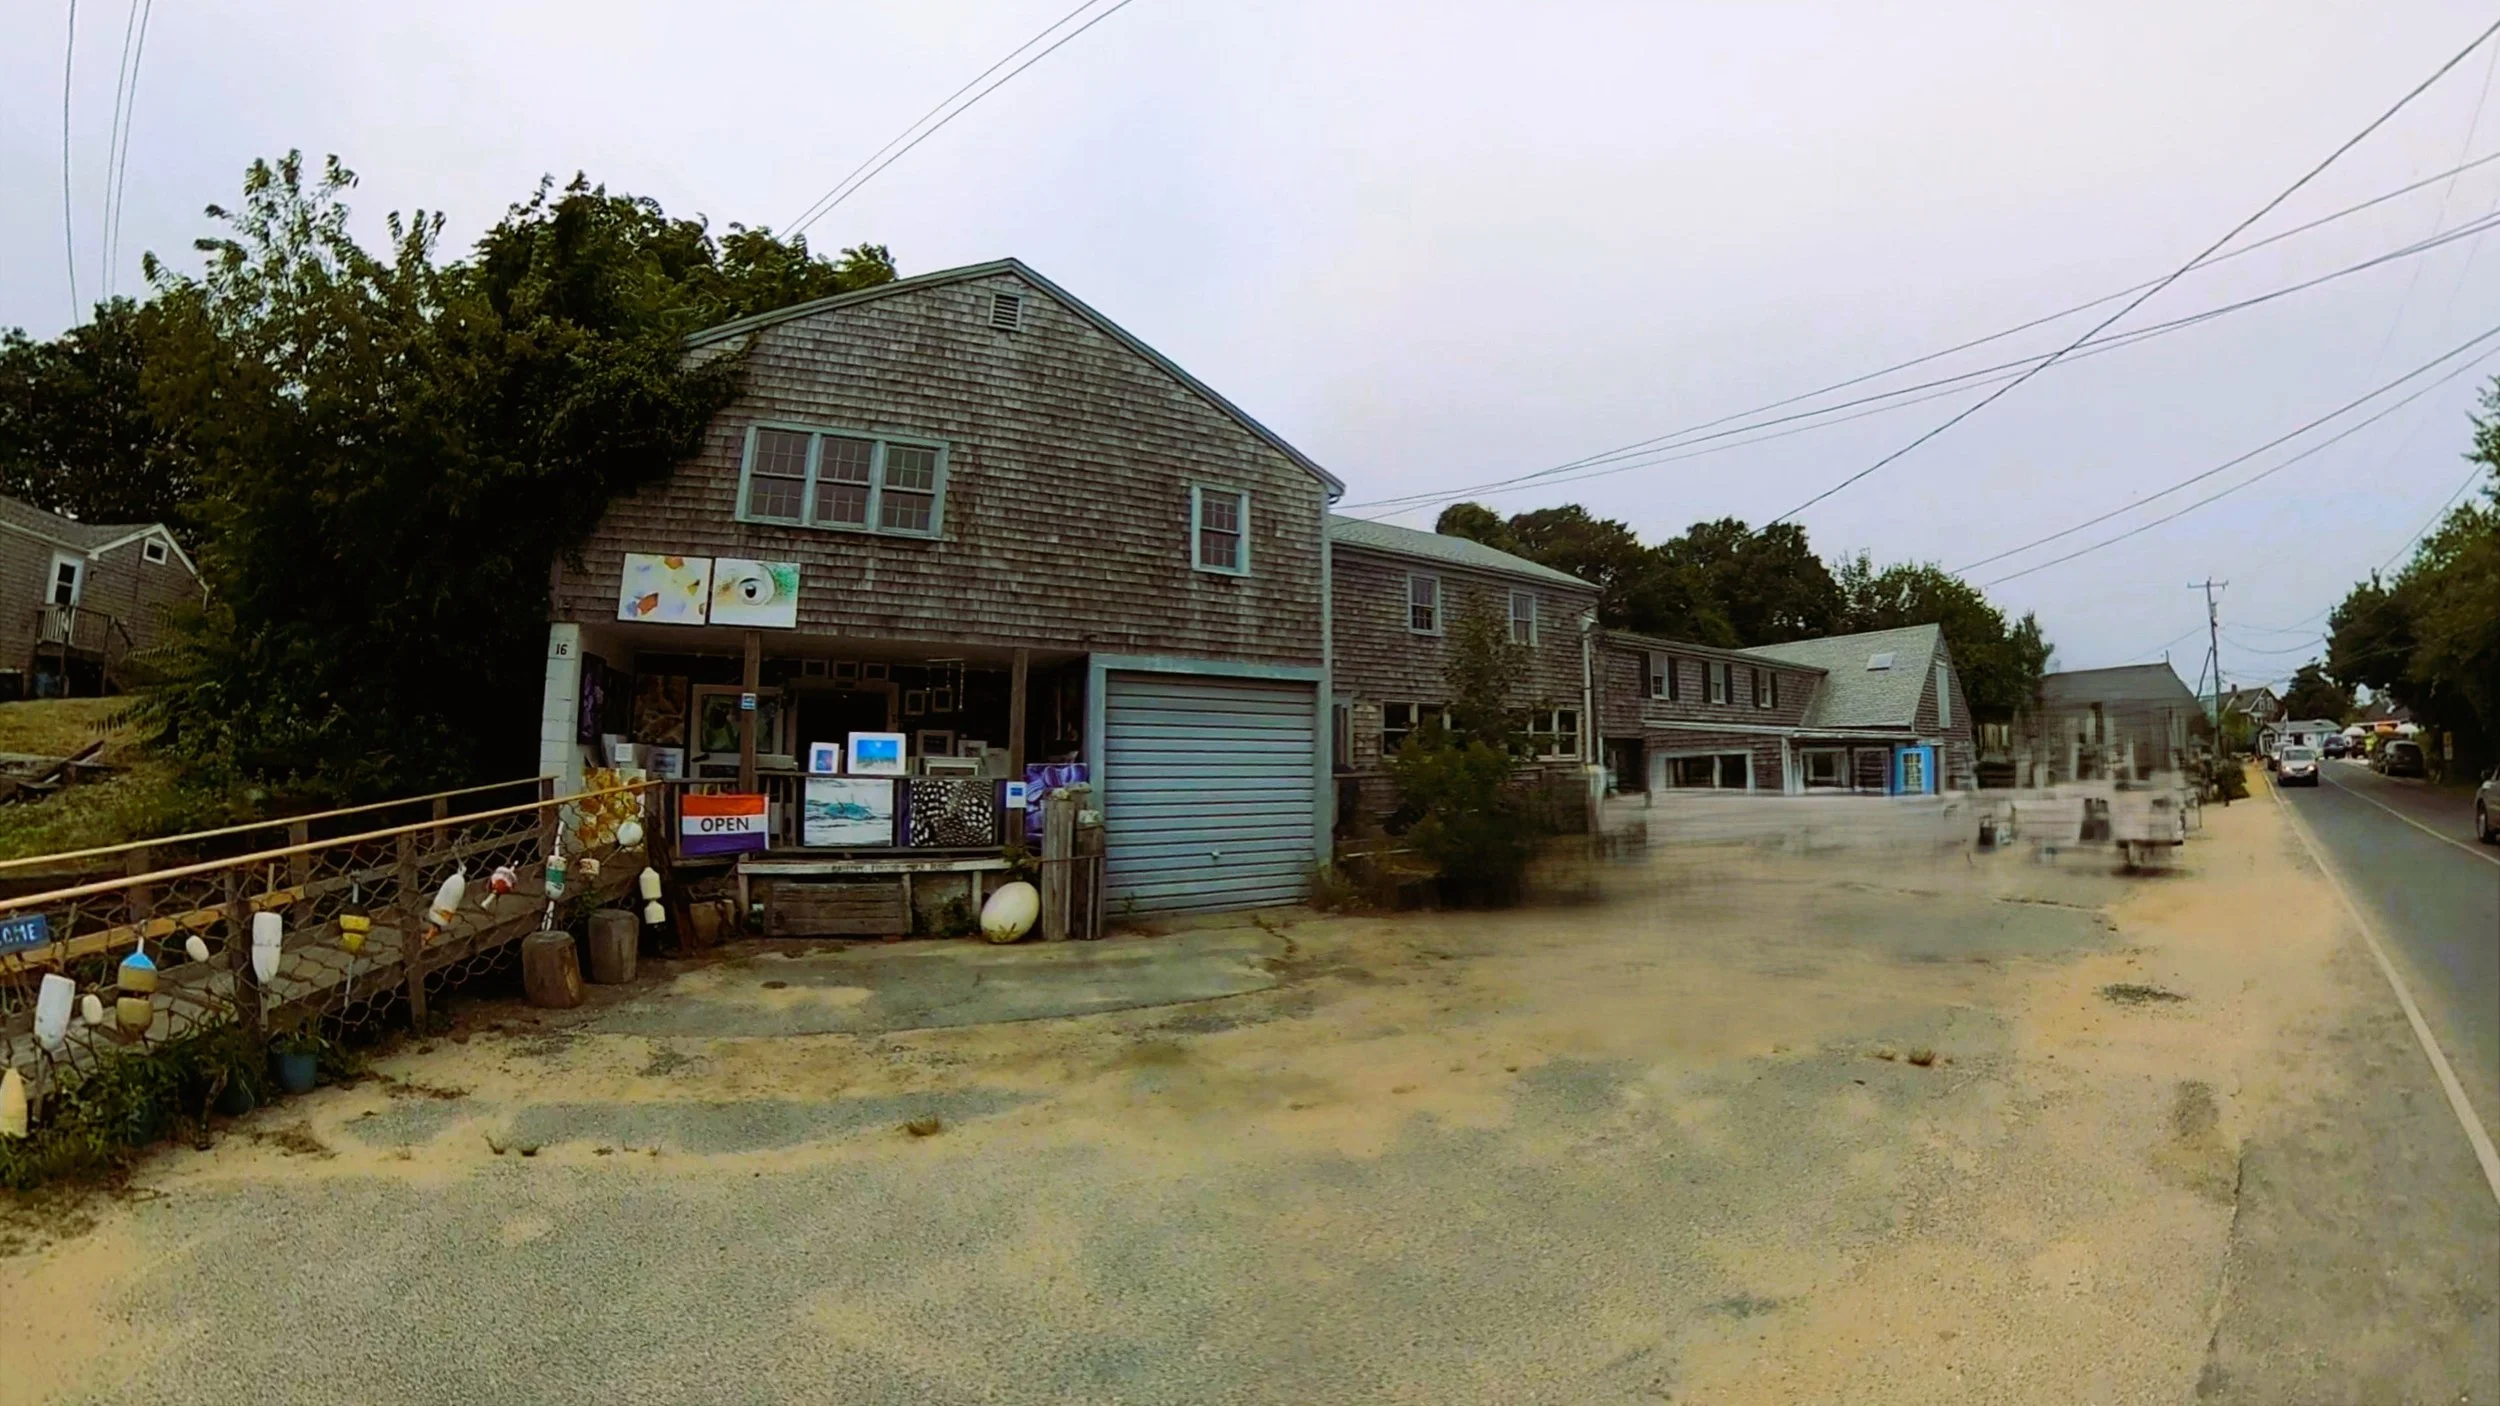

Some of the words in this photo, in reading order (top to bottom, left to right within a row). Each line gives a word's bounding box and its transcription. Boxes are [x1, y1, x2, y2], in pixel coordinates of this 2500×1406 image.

[556, 643, 568, 655] 16
[701, 817, 749, 832] OPEN
[0, 923, 36, 946] OME
